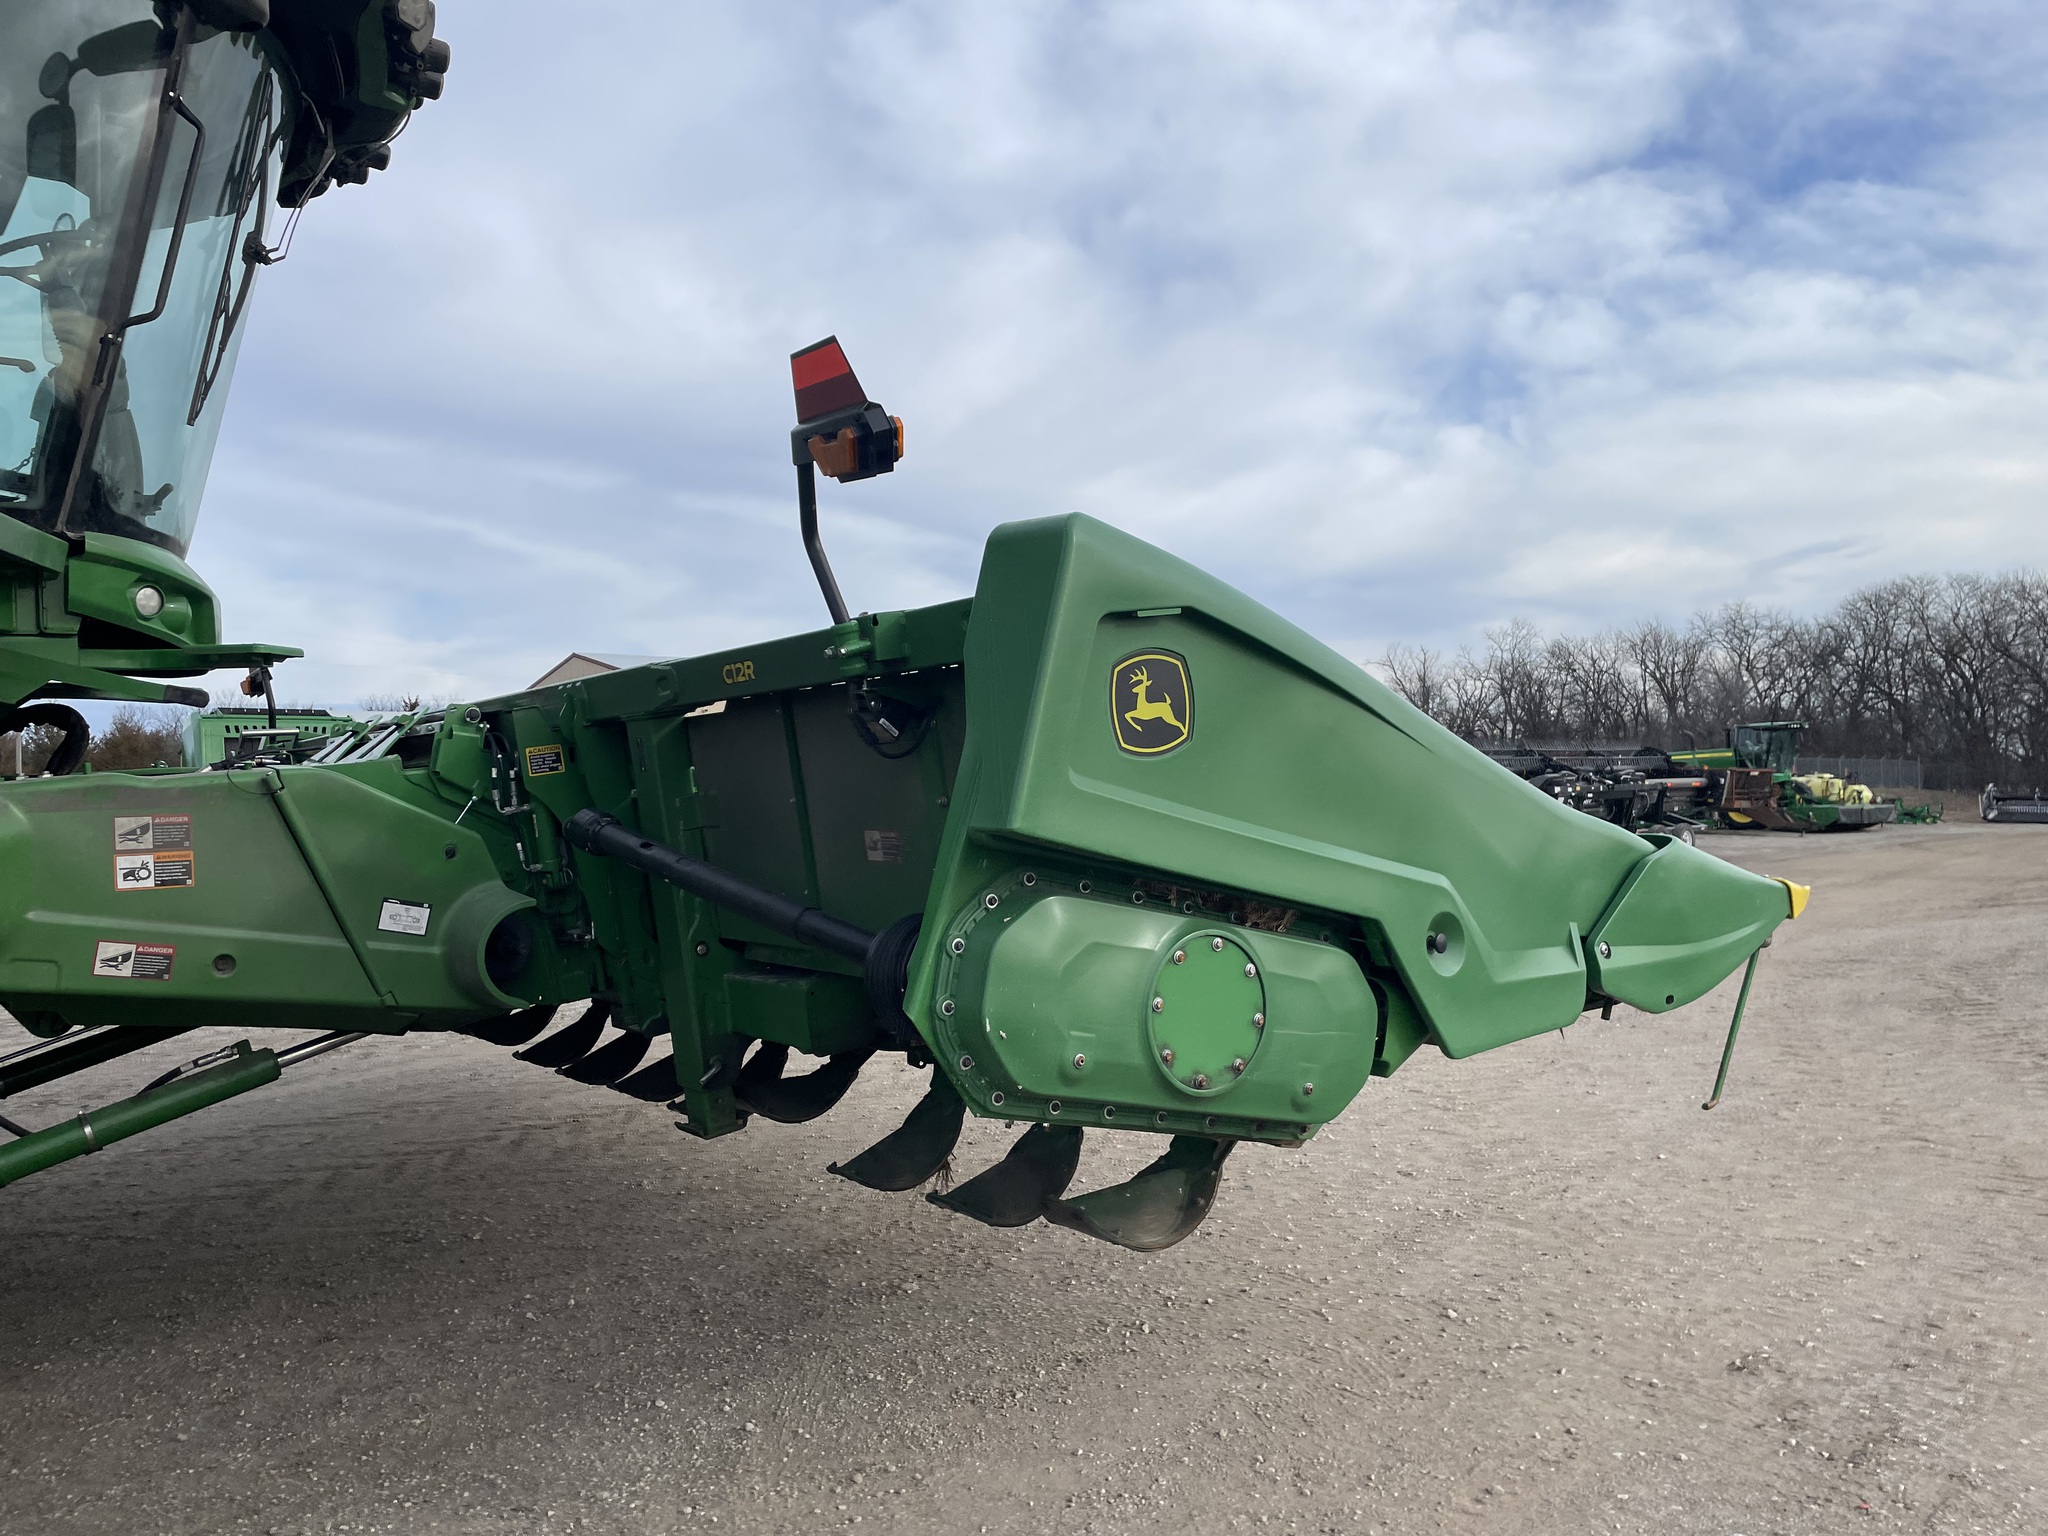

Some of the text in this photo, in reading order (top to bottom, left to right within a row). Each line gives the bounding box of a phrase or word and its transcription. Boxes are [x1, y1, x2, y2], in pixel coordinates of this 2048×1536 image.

[722, 661, 756, 684] C12R
[532, 745, 561, 754] CAUTION
[143, 946, 173, 954] DANGER
